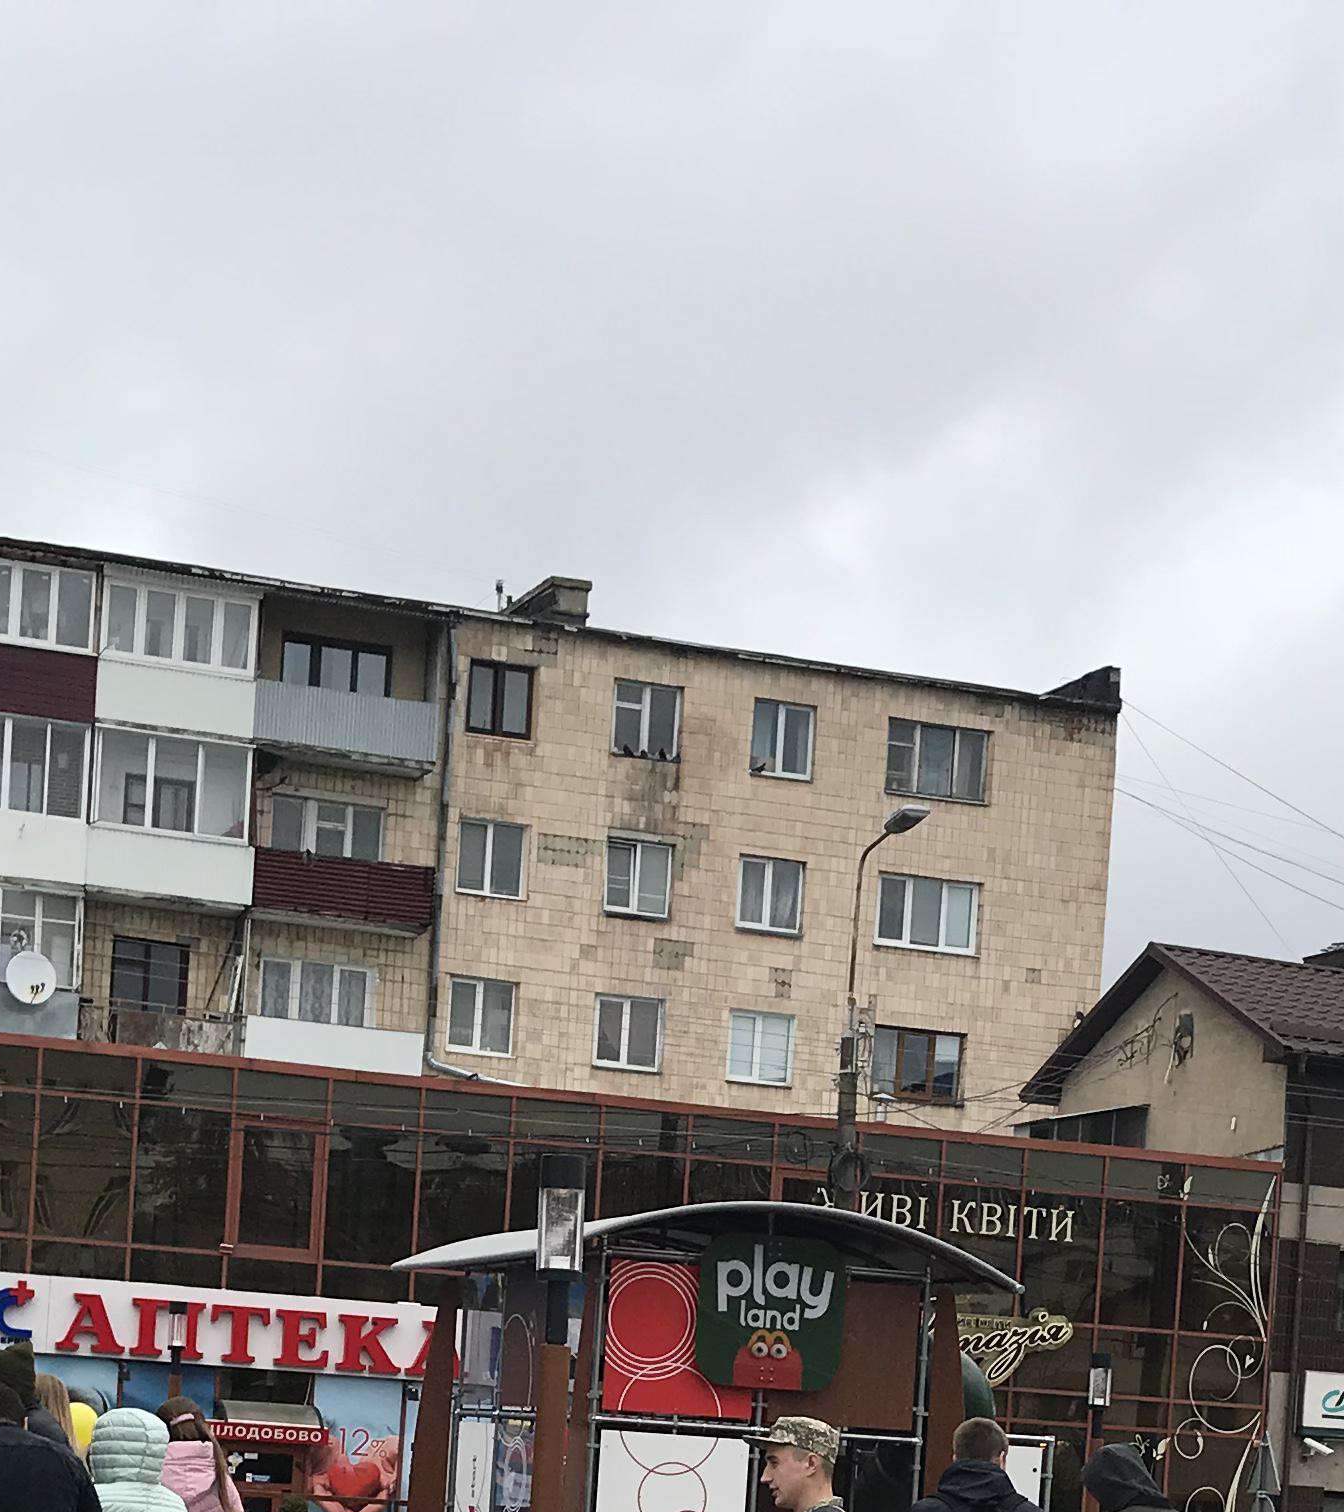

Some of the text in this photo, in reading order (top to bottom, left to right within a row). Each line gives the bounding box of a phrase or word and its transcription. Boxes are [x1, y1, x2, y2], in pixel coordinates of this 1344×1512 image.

[816, 1187, 928, 1229] ИВІ
[716, 1243, 835, 1319] play
[739, 1300, 801, 1331] land
